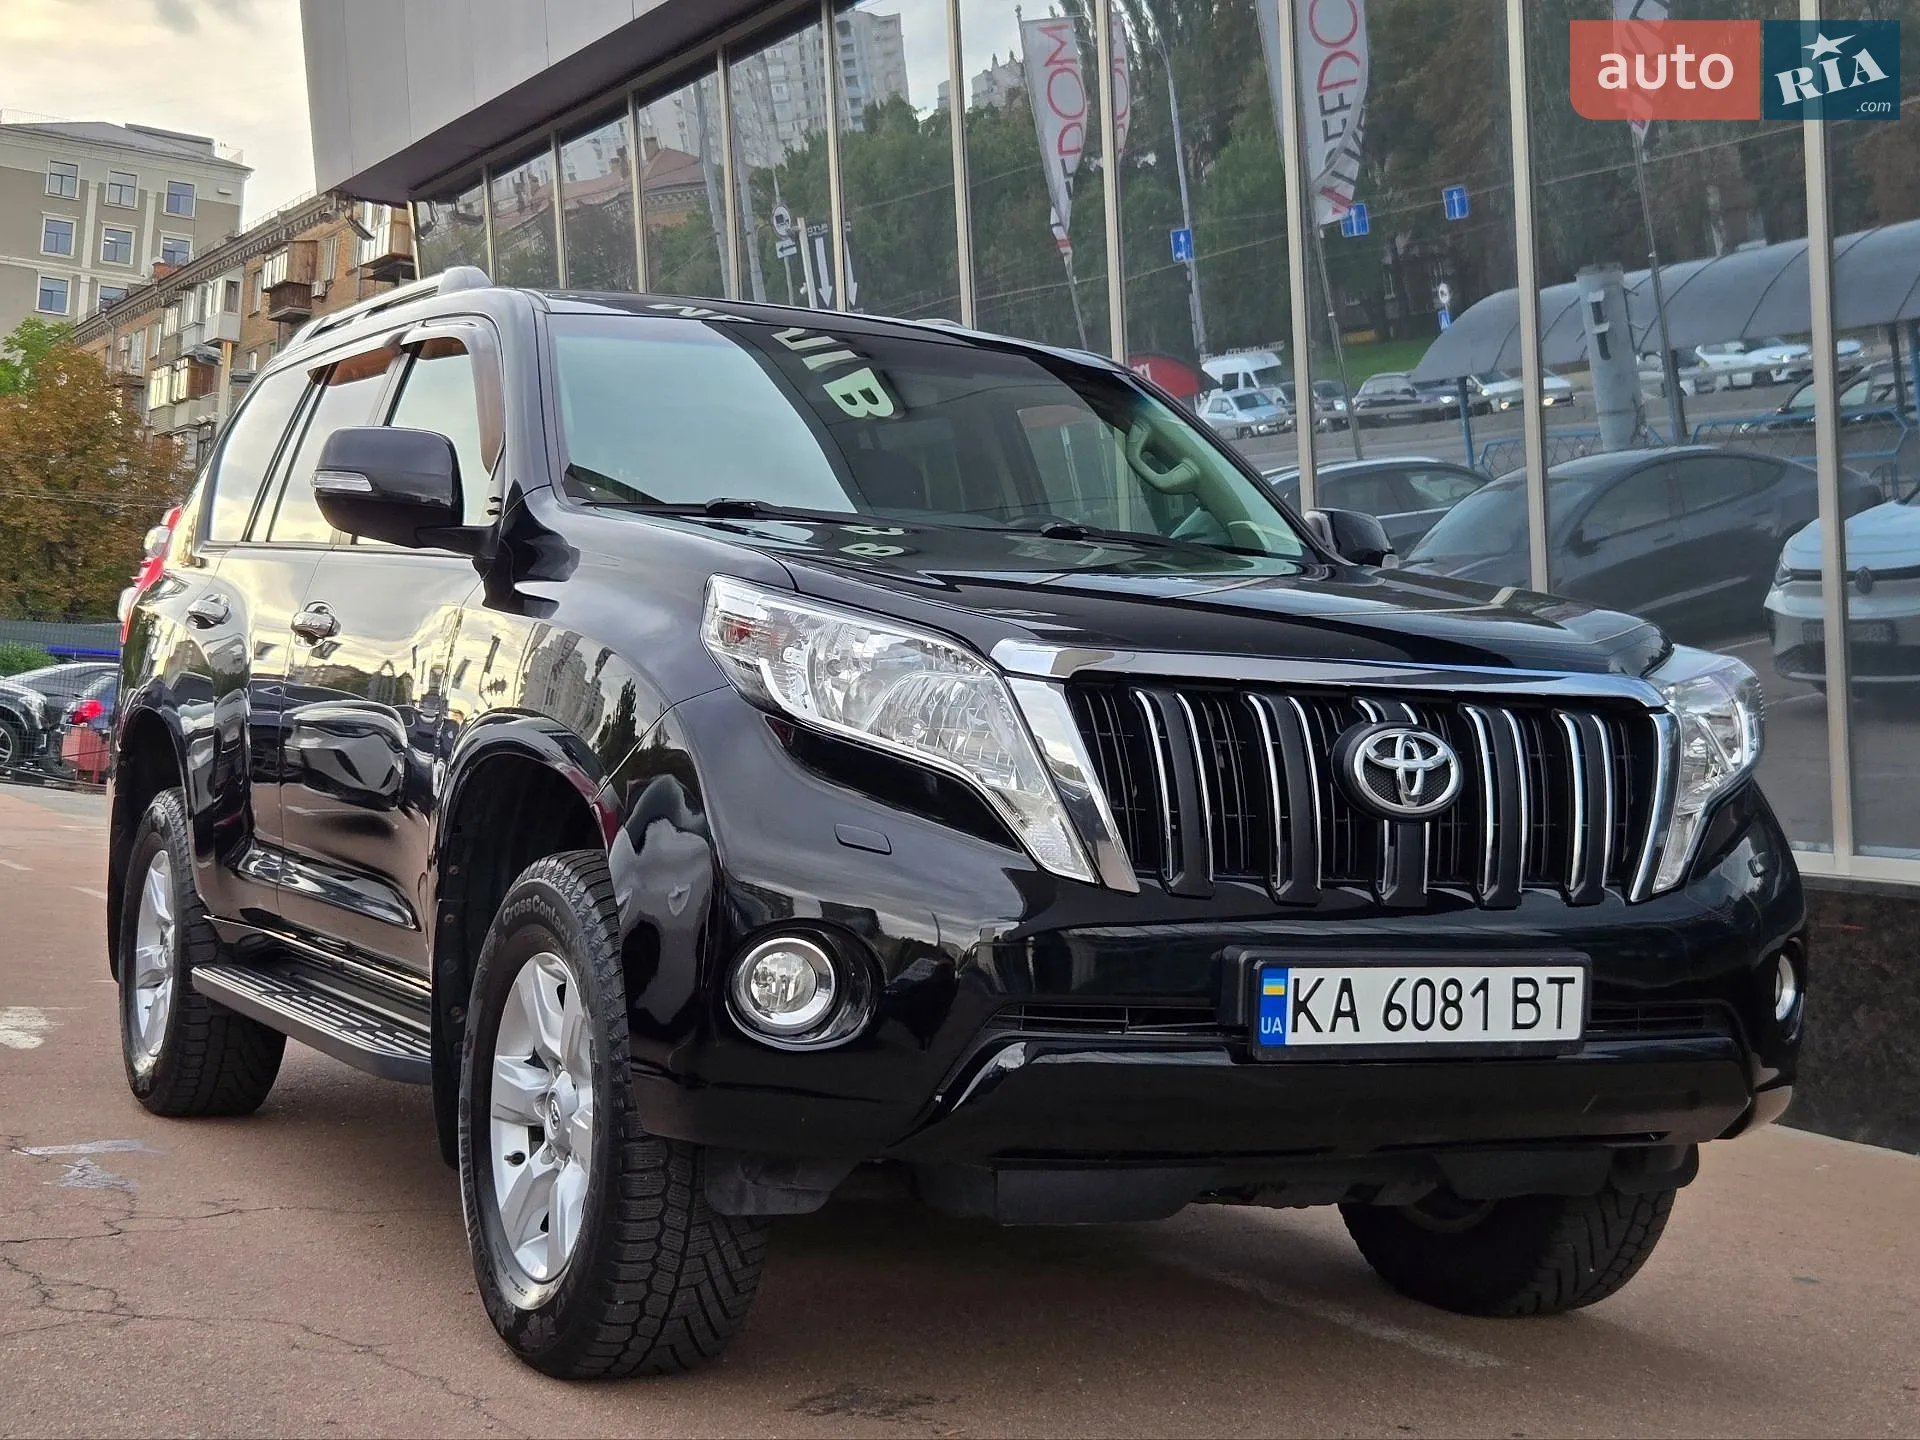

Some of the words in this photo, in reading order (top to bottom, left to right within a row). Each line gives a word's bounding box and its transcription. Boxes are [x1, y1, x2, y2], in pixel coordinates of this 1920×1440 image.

[1290, 976, 1361, 1034] KA
[1381, 976, 1490, 1033] 6081
[1511, 976, 1576, 1031] BT
[1261, 1016, 1283, 1035] UA
